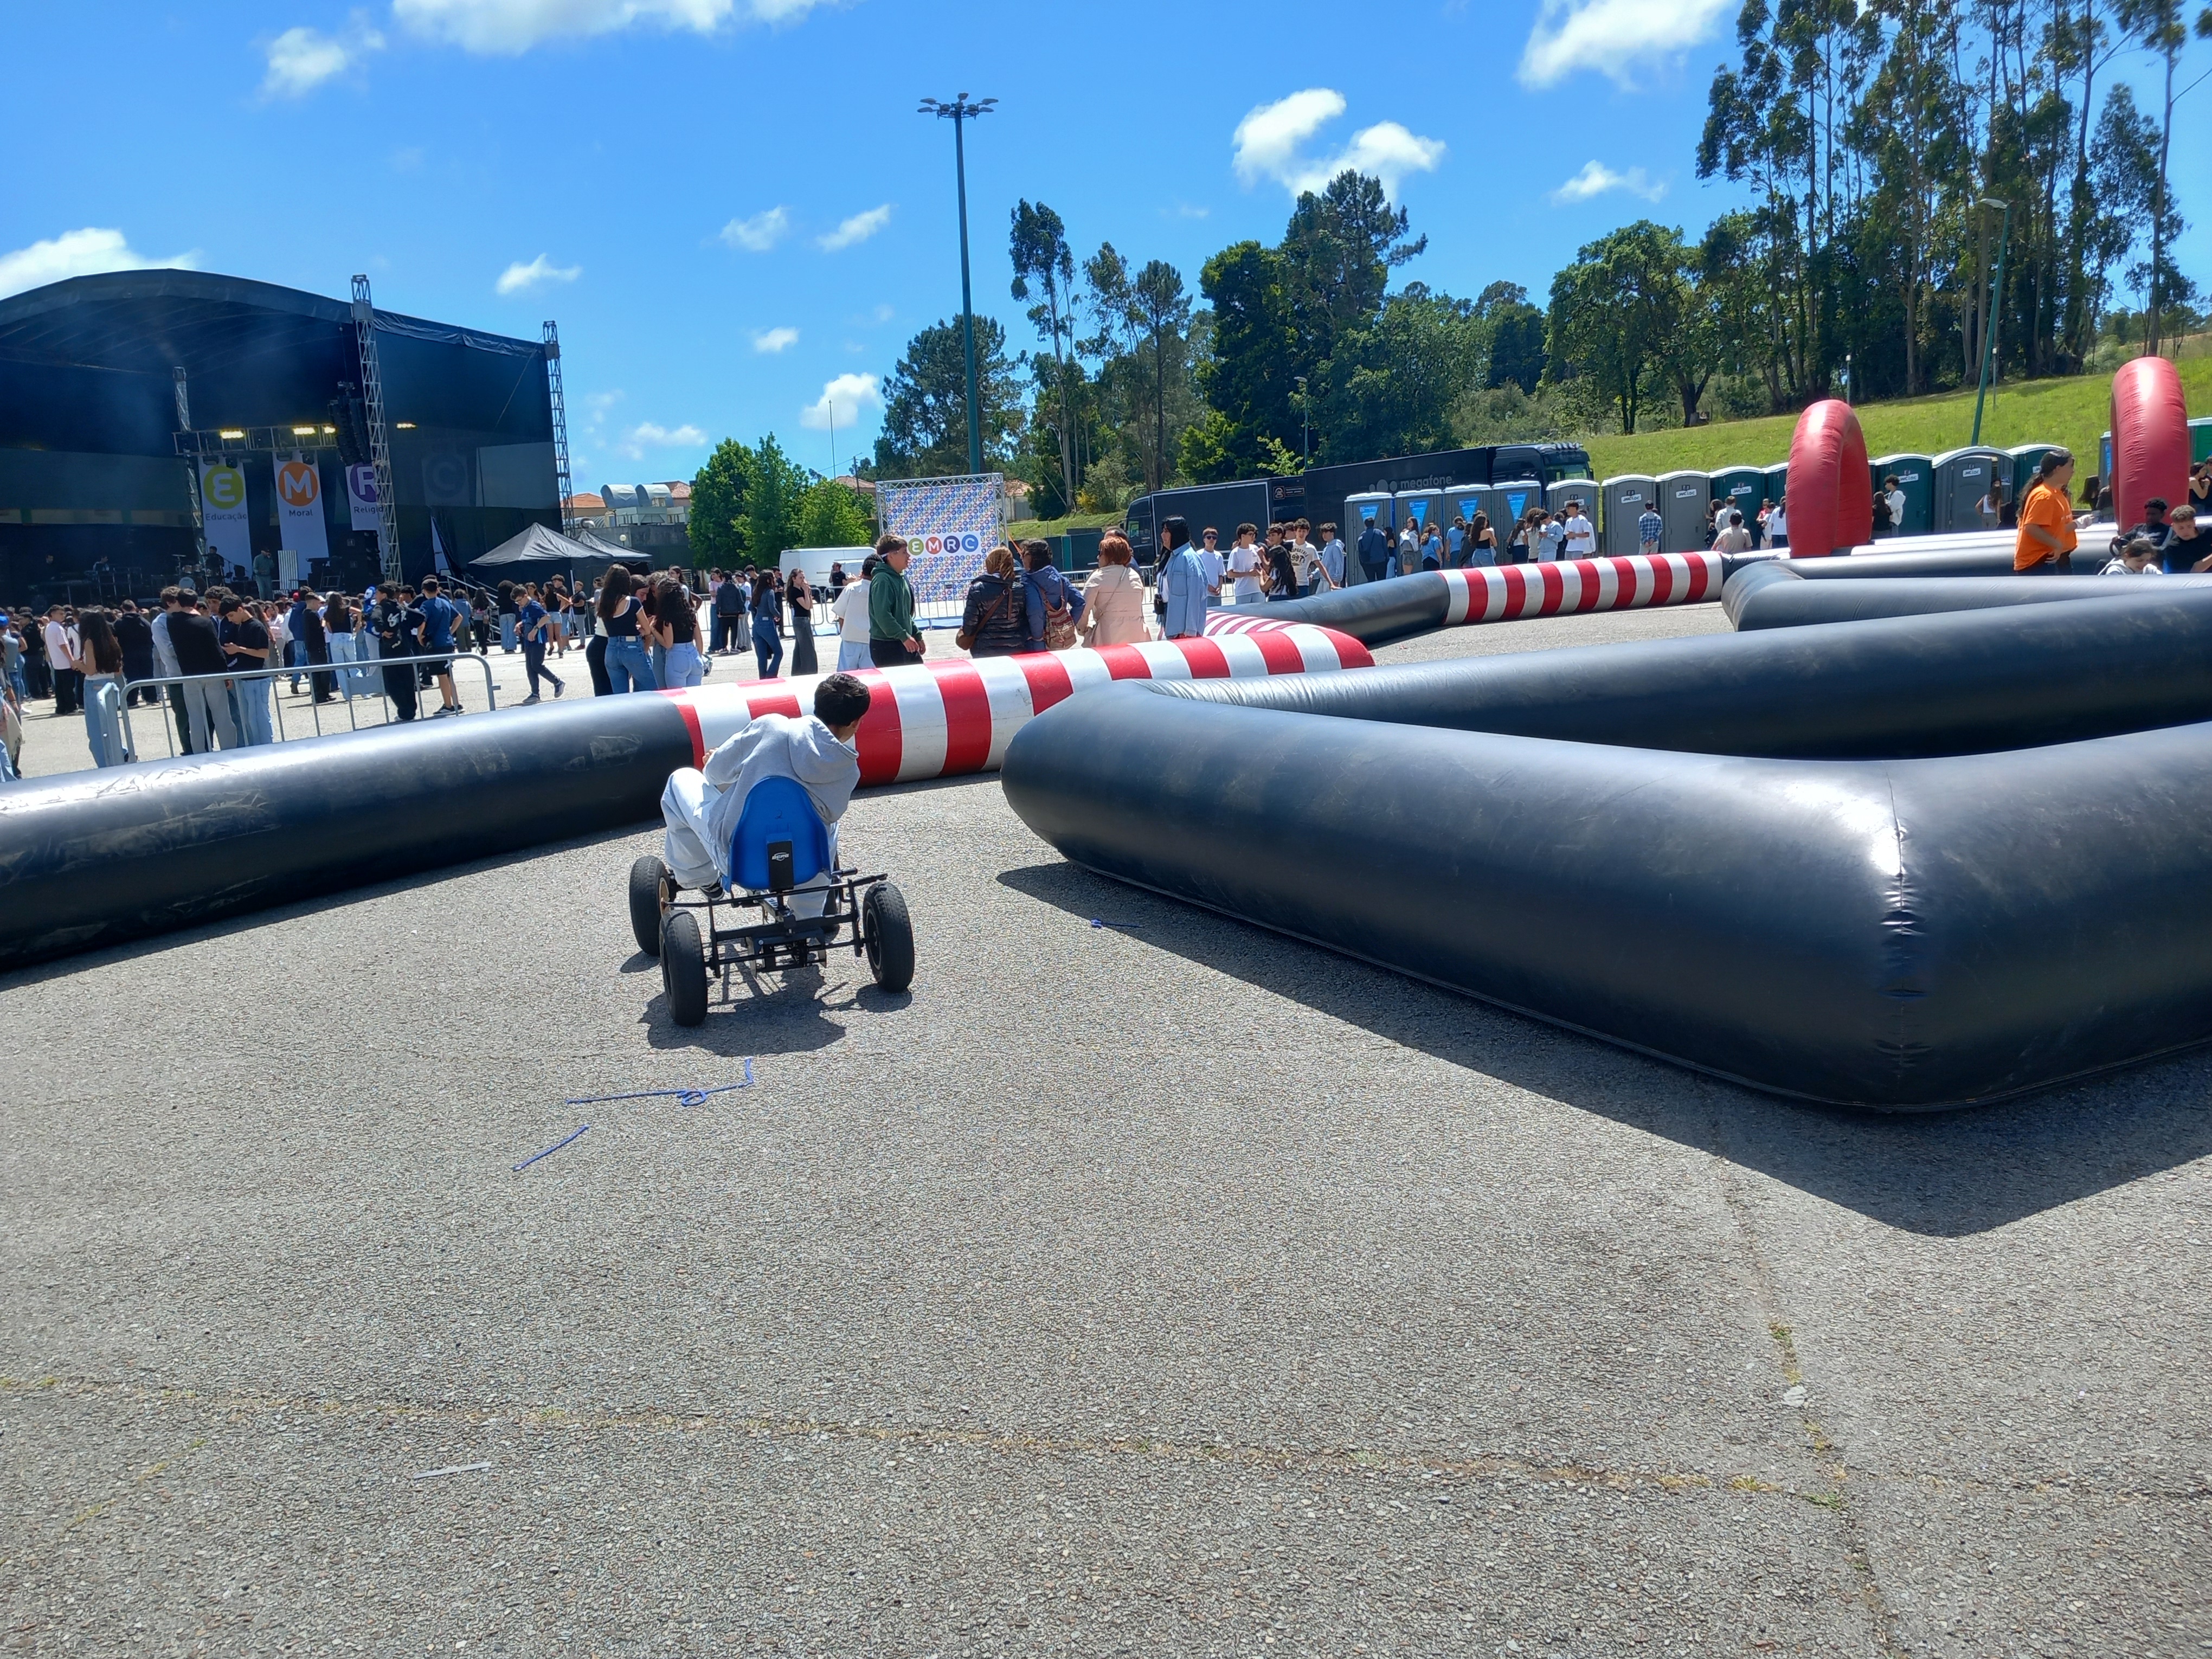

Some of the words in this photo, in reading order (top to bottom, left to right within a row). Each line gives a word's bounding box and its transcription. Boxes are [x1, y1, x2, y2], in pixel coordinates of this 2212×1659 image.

[213, 473, 235, 502] E
[284, 470, 313, 499] M
[205, 512, 247, 522] Educação
[288, 509, 313, 517] Moral
